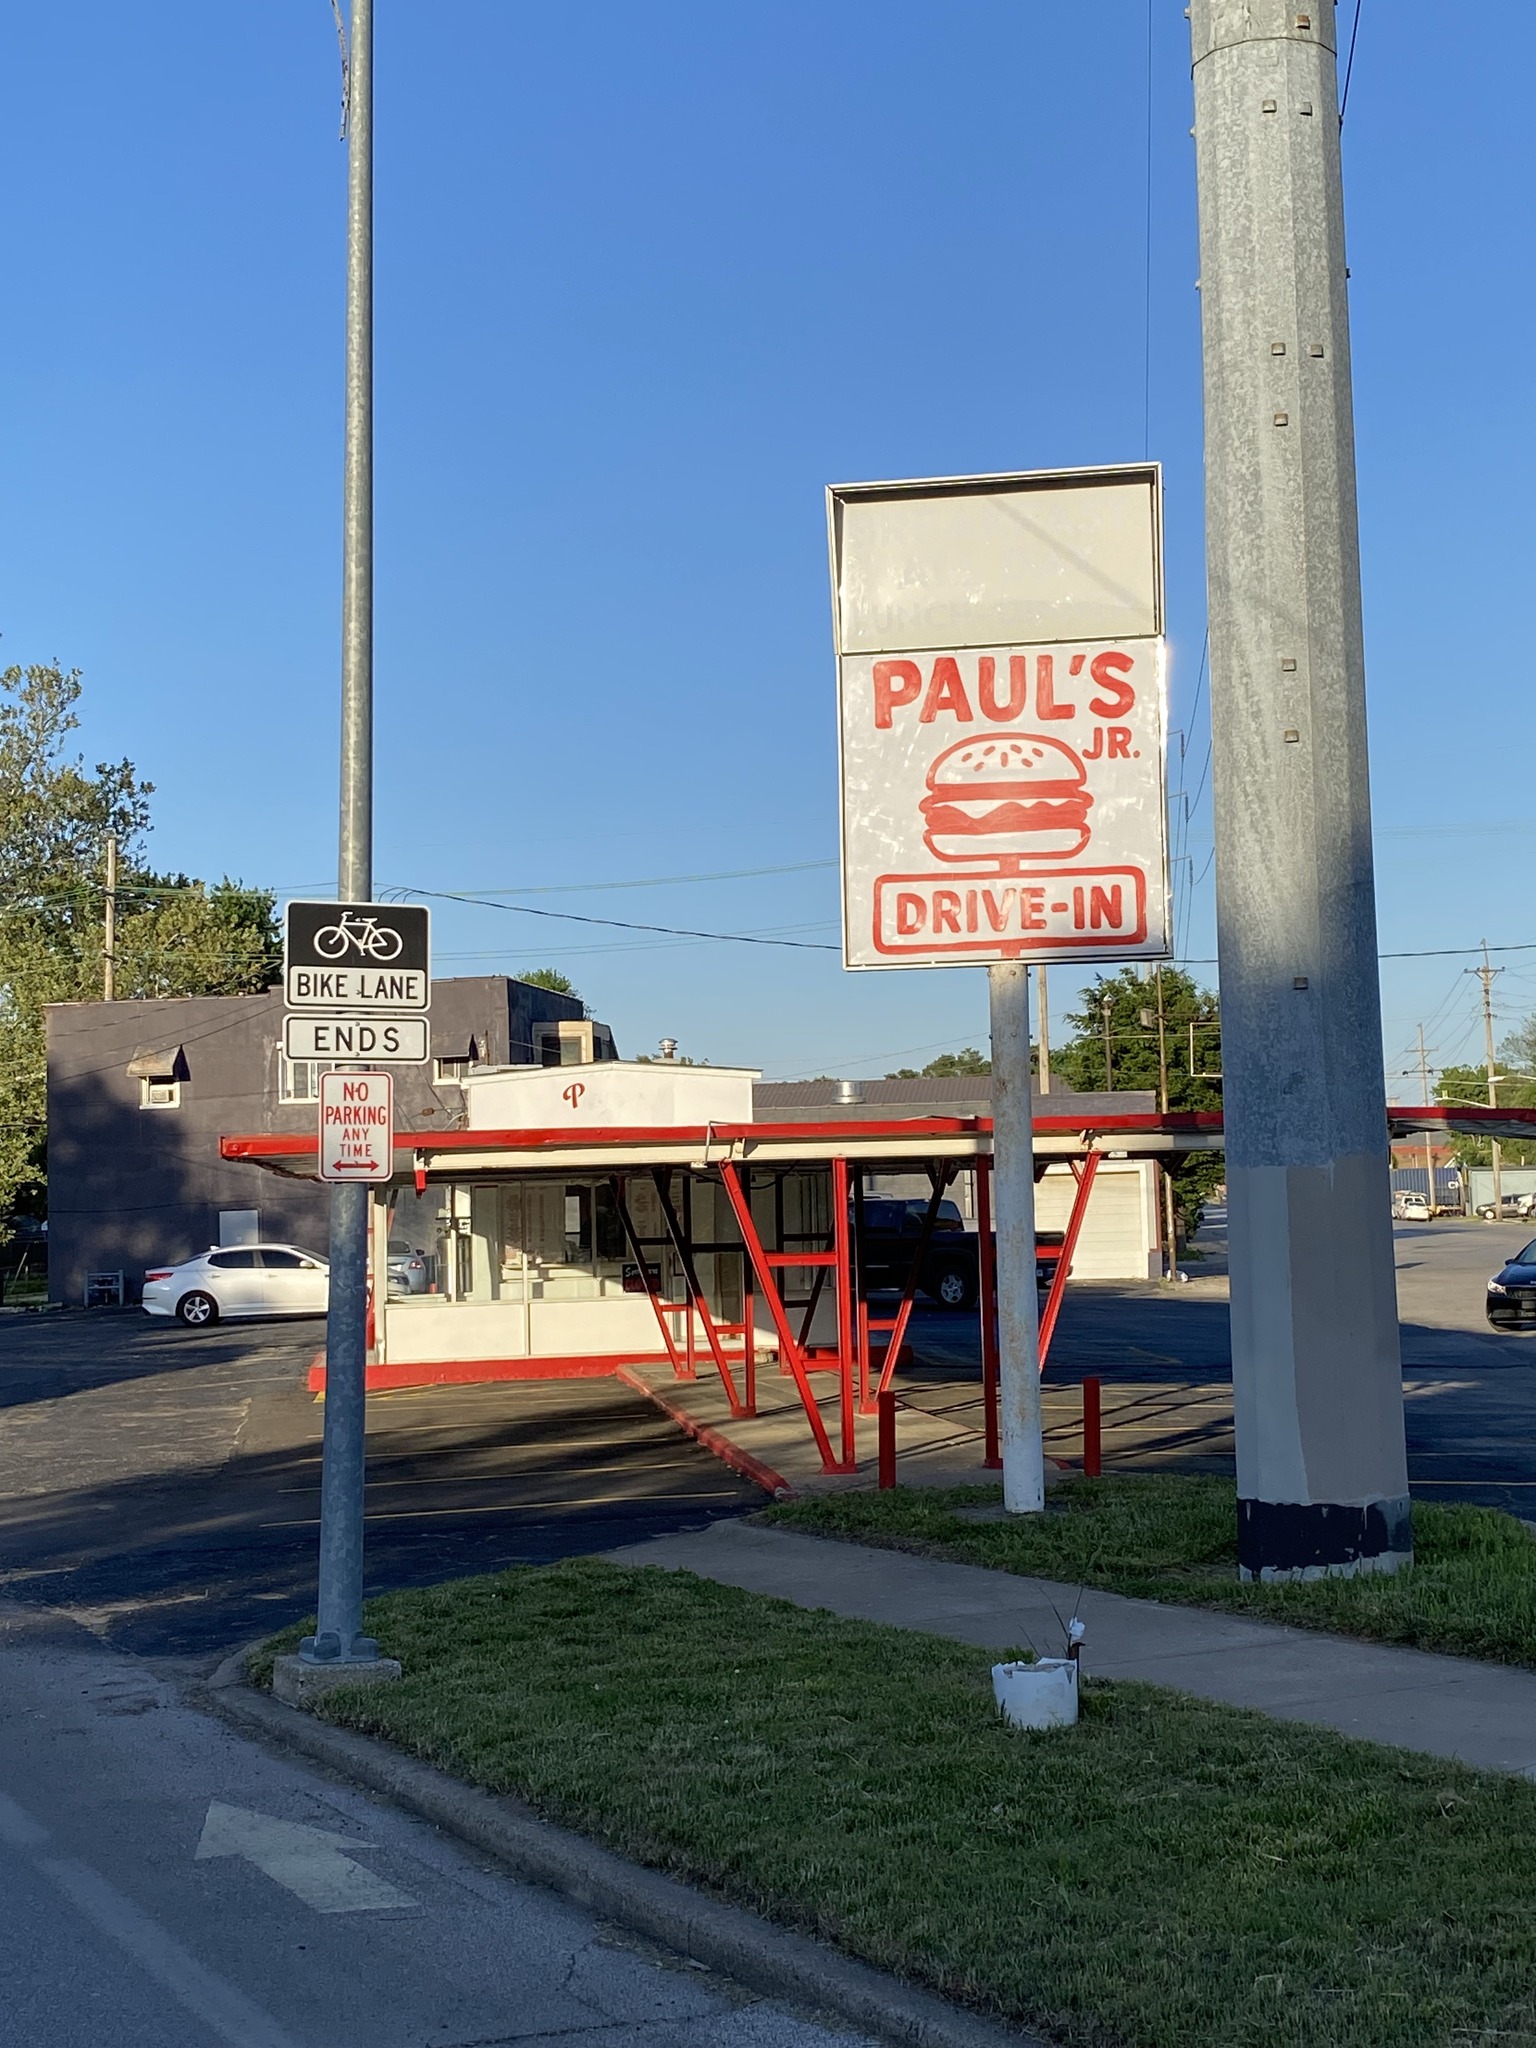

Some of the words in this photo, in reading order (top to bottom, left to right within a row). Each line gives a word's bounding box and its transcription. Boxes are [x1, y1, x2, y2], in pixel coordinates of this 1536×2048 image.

[873, 652, 1135, 729] PAUL'S
[1082, 726, 1141, 759] JR.
[896, 884, 1122, 935] DRIVE-IN
[297, 973, 348, 998] BIKE
[360, 974, 418, 1000] LANE
[314, 1026, 400, 1053] ENDS
[343, 1082, 369, 1102] NO
[562, 1082, 585, 1109] P
[325, 1105, 387, 1125] PARKING
[342, 1128, 370, 1141] ANY
[340, 1143, 373, 1157] TIME
